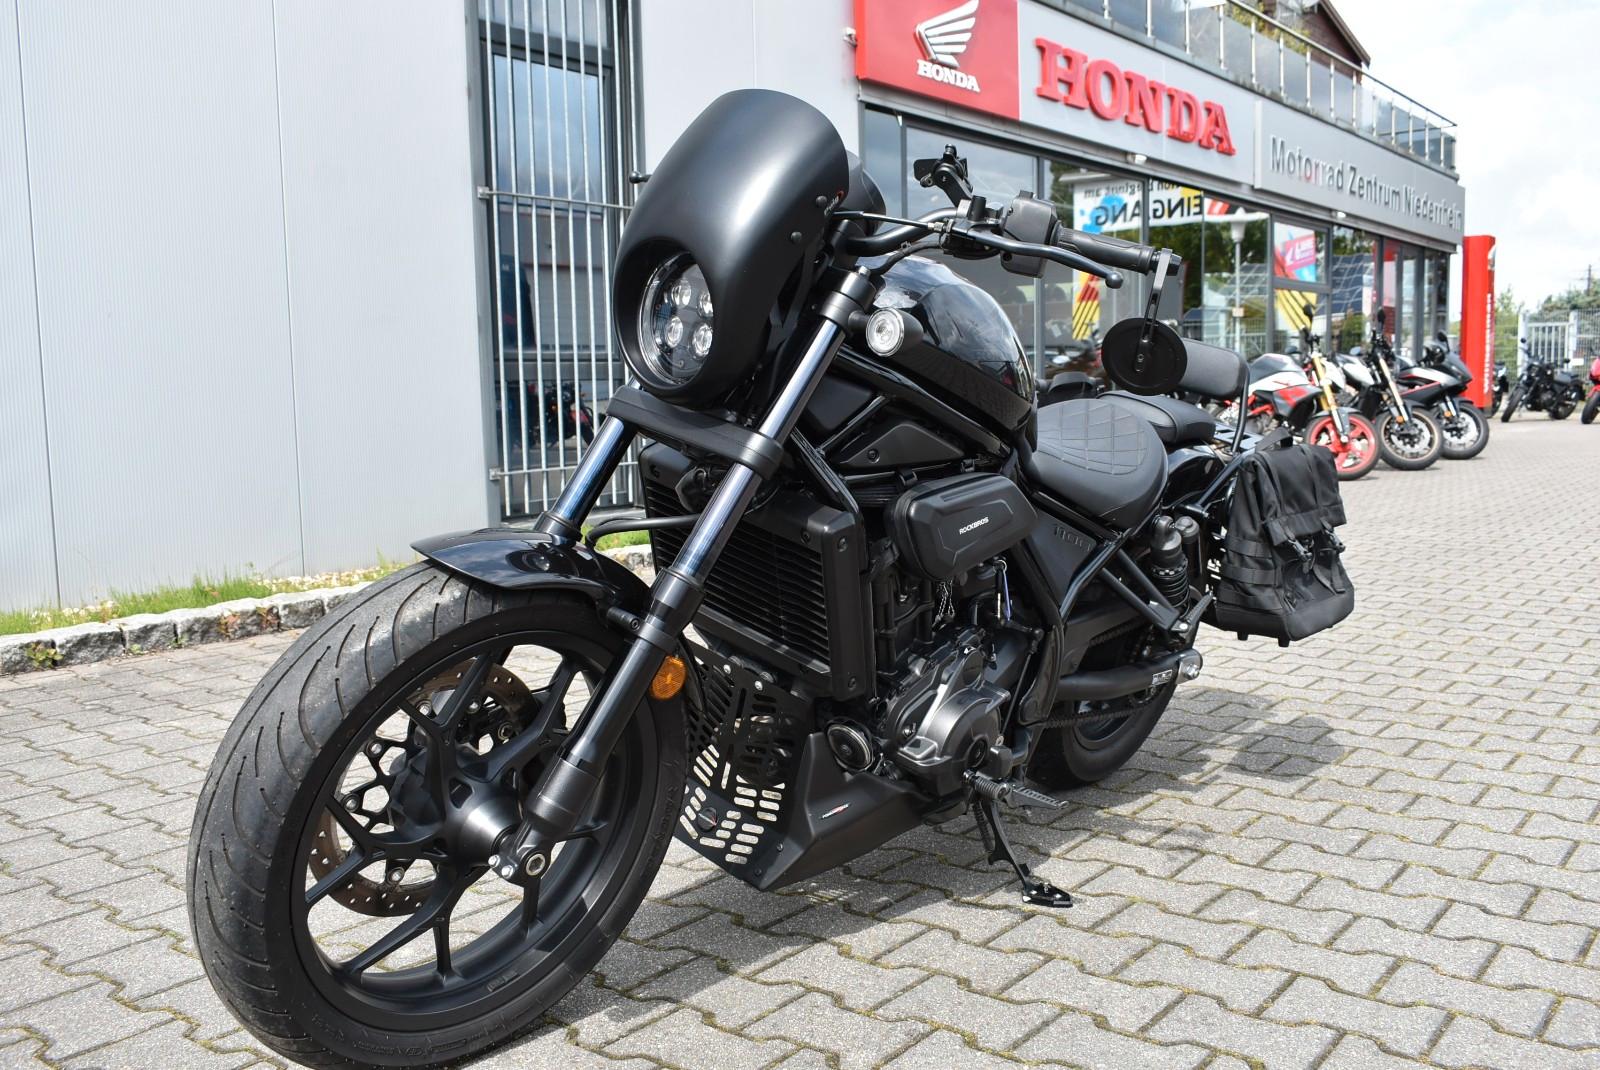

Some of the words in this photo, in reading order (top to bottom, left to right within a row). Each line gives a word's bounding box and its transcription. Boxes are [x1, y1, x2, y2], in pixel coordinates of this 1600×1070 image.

[917, 59, 981, 93] HONDA
[1033, 37, 1237, 156] HONDA
[1271, 135, 1344, 191] Motorrad
[1348, 164, 1400, 212] Zentrum
[1402, 184, 1463, 231] Niederrhein
[959, 516, 989, 535] ROCKBROS
